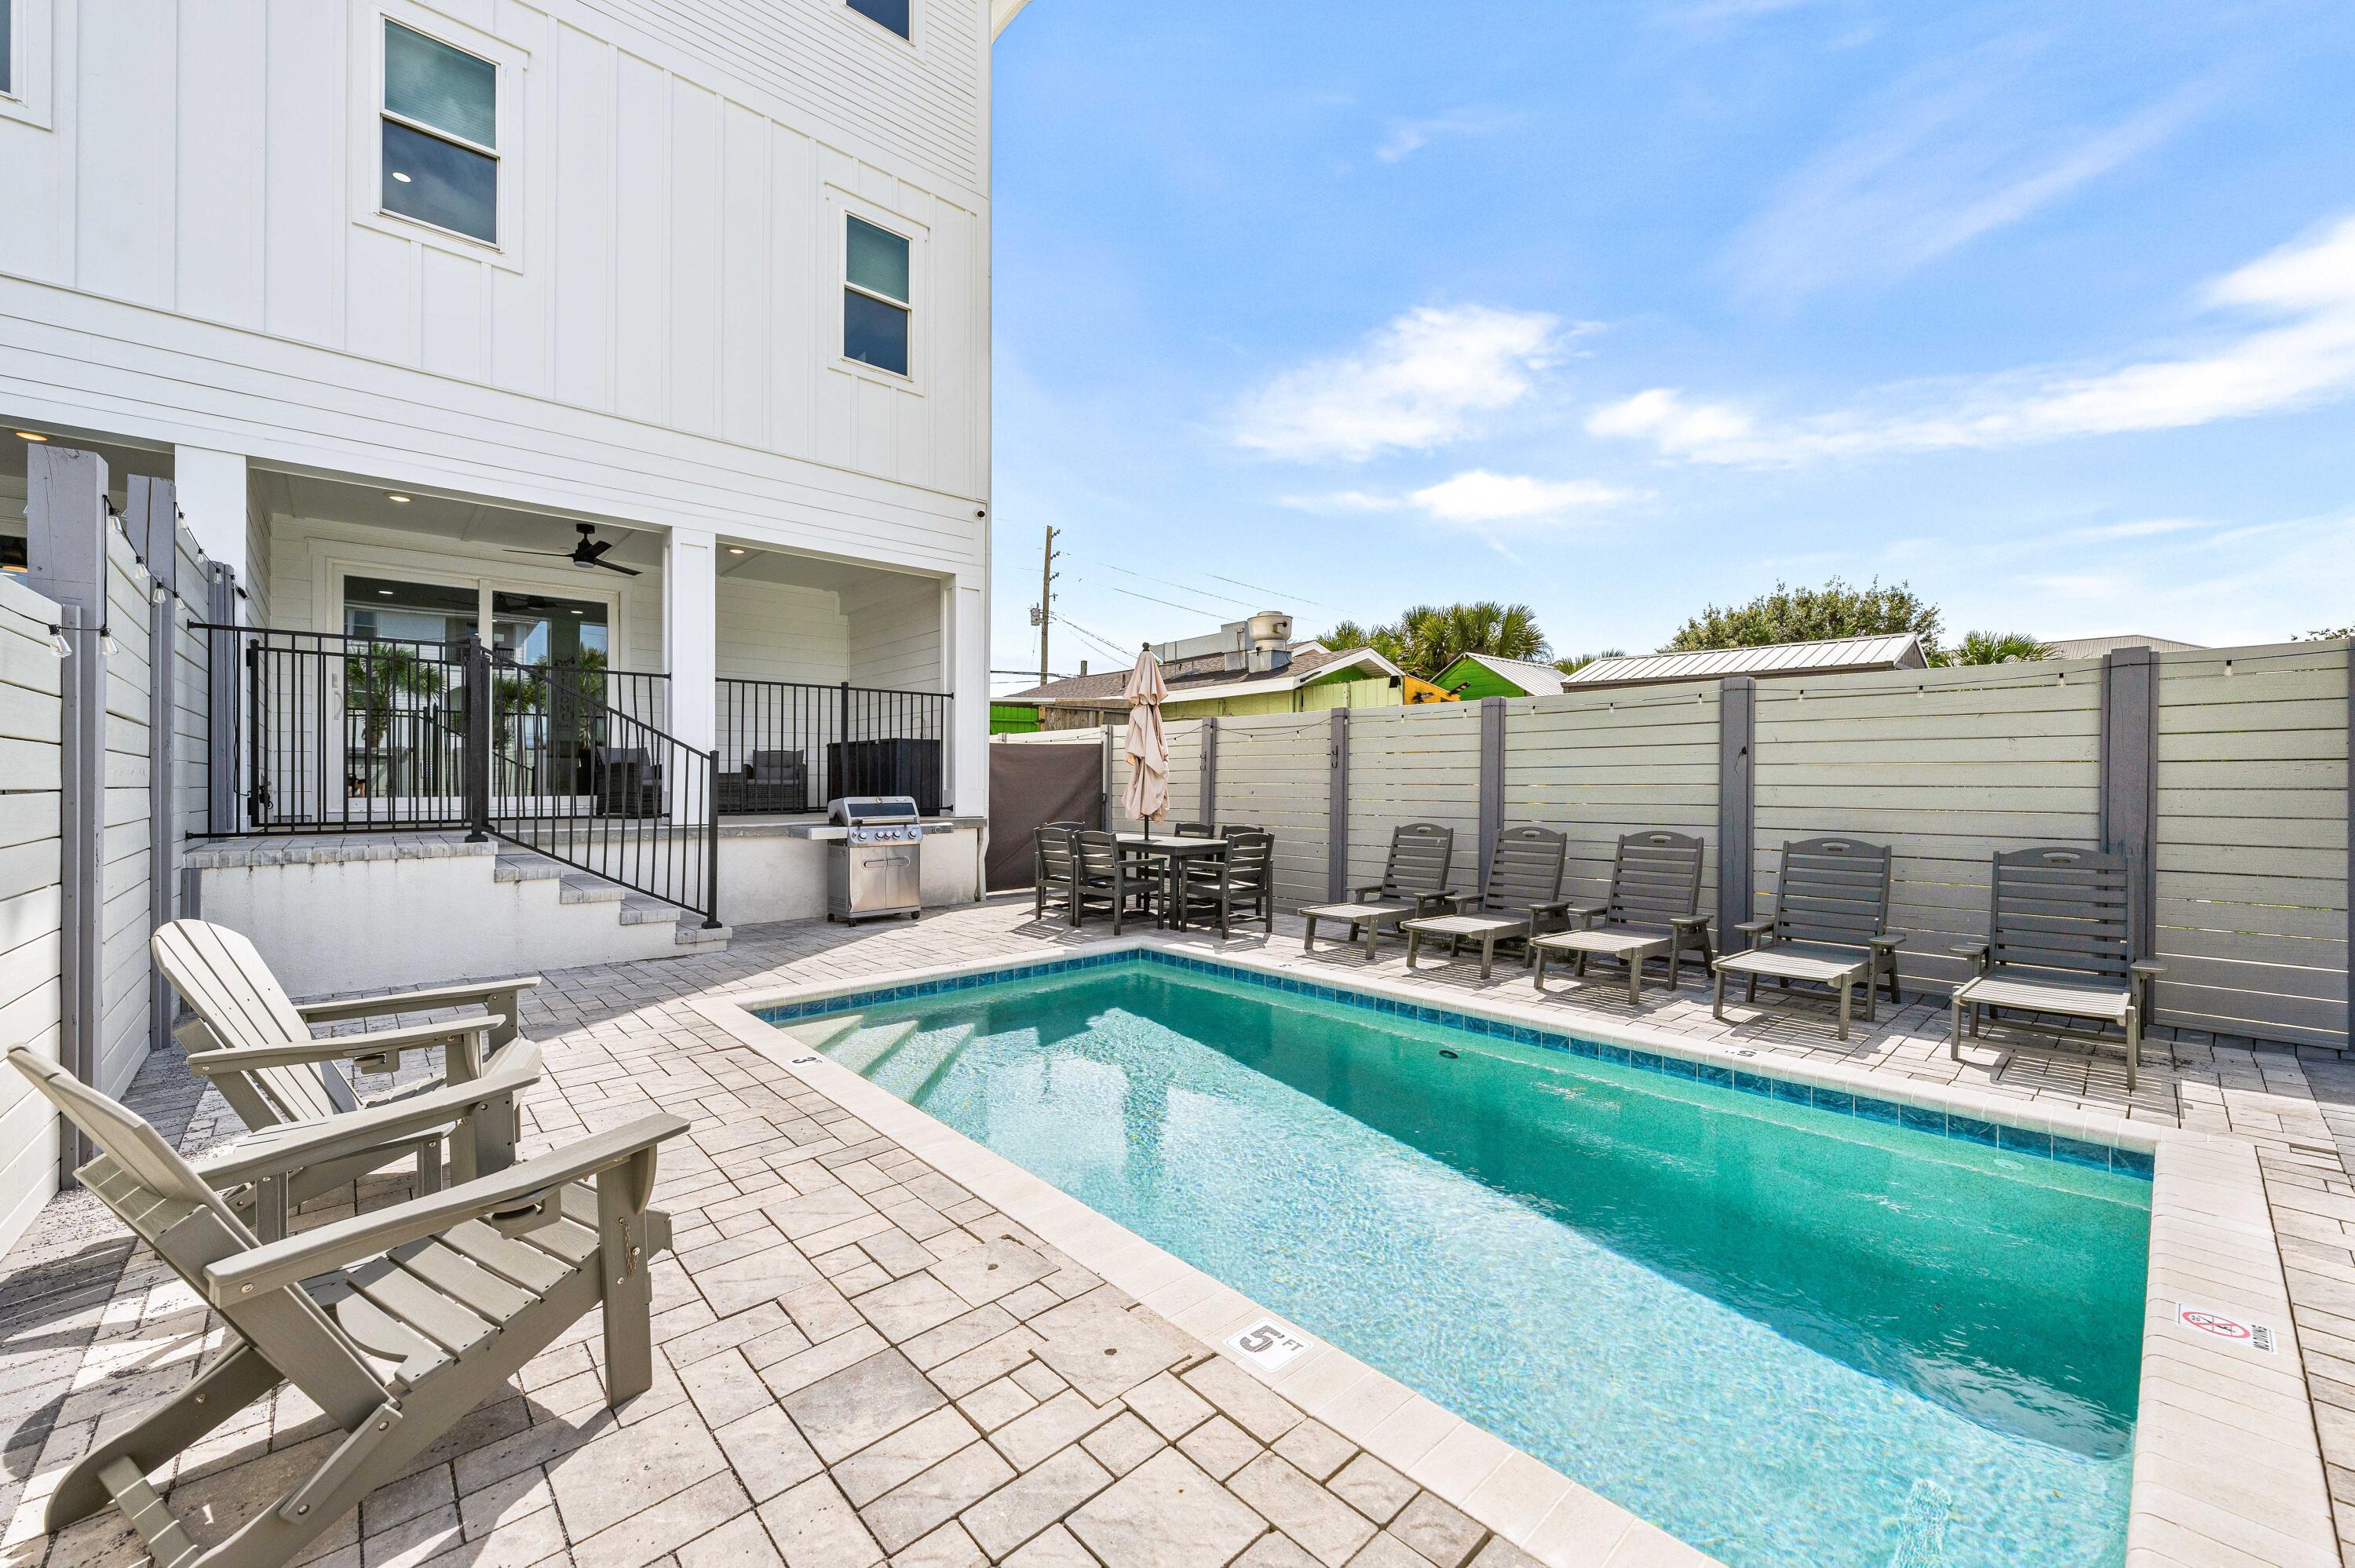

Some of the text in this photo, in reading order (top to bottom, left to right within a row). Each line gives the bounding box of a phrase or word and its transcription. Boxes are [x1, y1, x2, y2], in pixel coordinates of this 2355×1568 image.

[1240, 1325, 1304, 1352] 5 FT
[2251, 1325, 2269, 1351] NO DIVING
